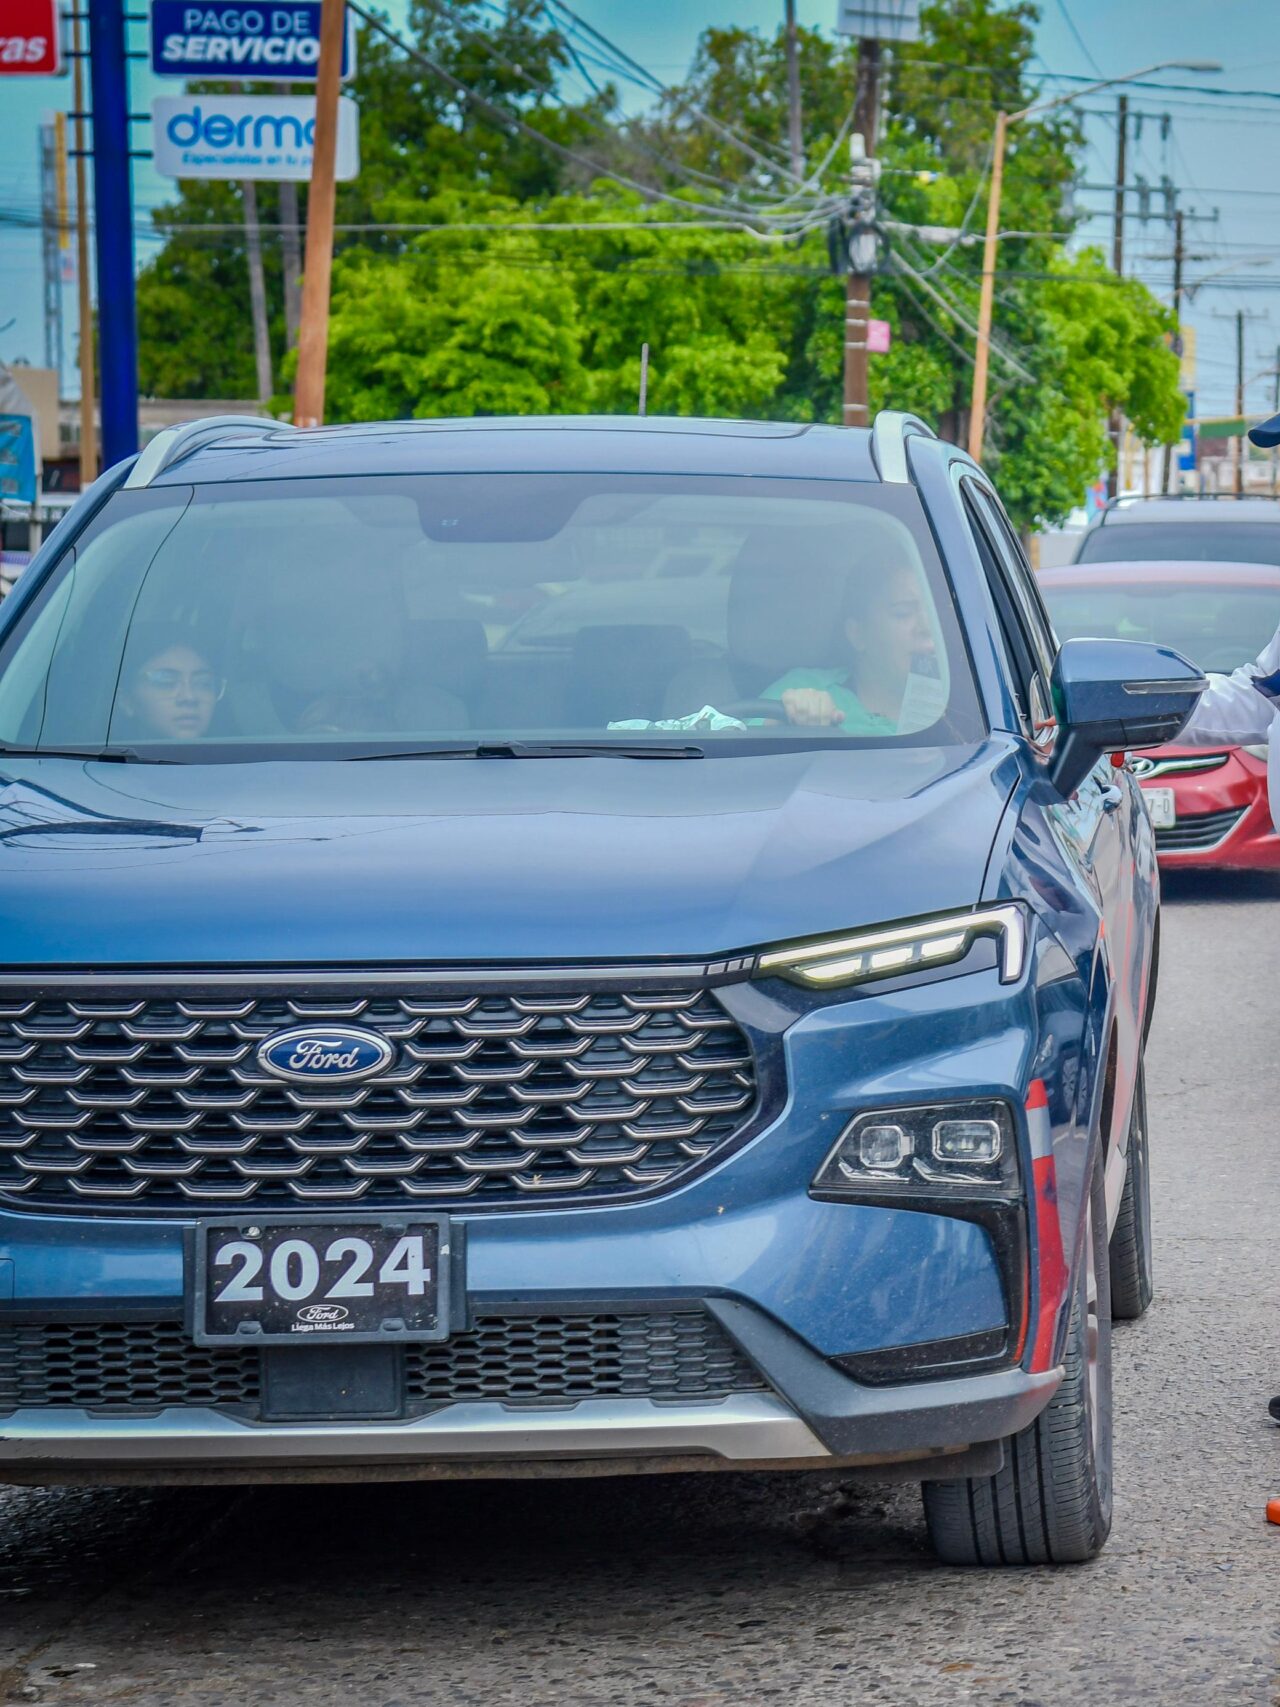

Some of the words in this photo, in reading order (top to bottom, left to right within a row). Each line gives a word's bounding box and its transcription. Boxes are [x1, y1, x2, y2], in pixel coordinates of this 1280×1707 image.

[184, 9, 264, 34] PAGO
[271, 11, 311, 34] DE
[289, 1040, 360, 1069] Ford
[214, 1235, 432, 1302] 2024
[306, 1306, 340, 1320] Ford
[291, 1323, 314, 1332] Llega
[314, 1322, 332, 1330] Más
[332, 1321, 355, 1331] Lejos
